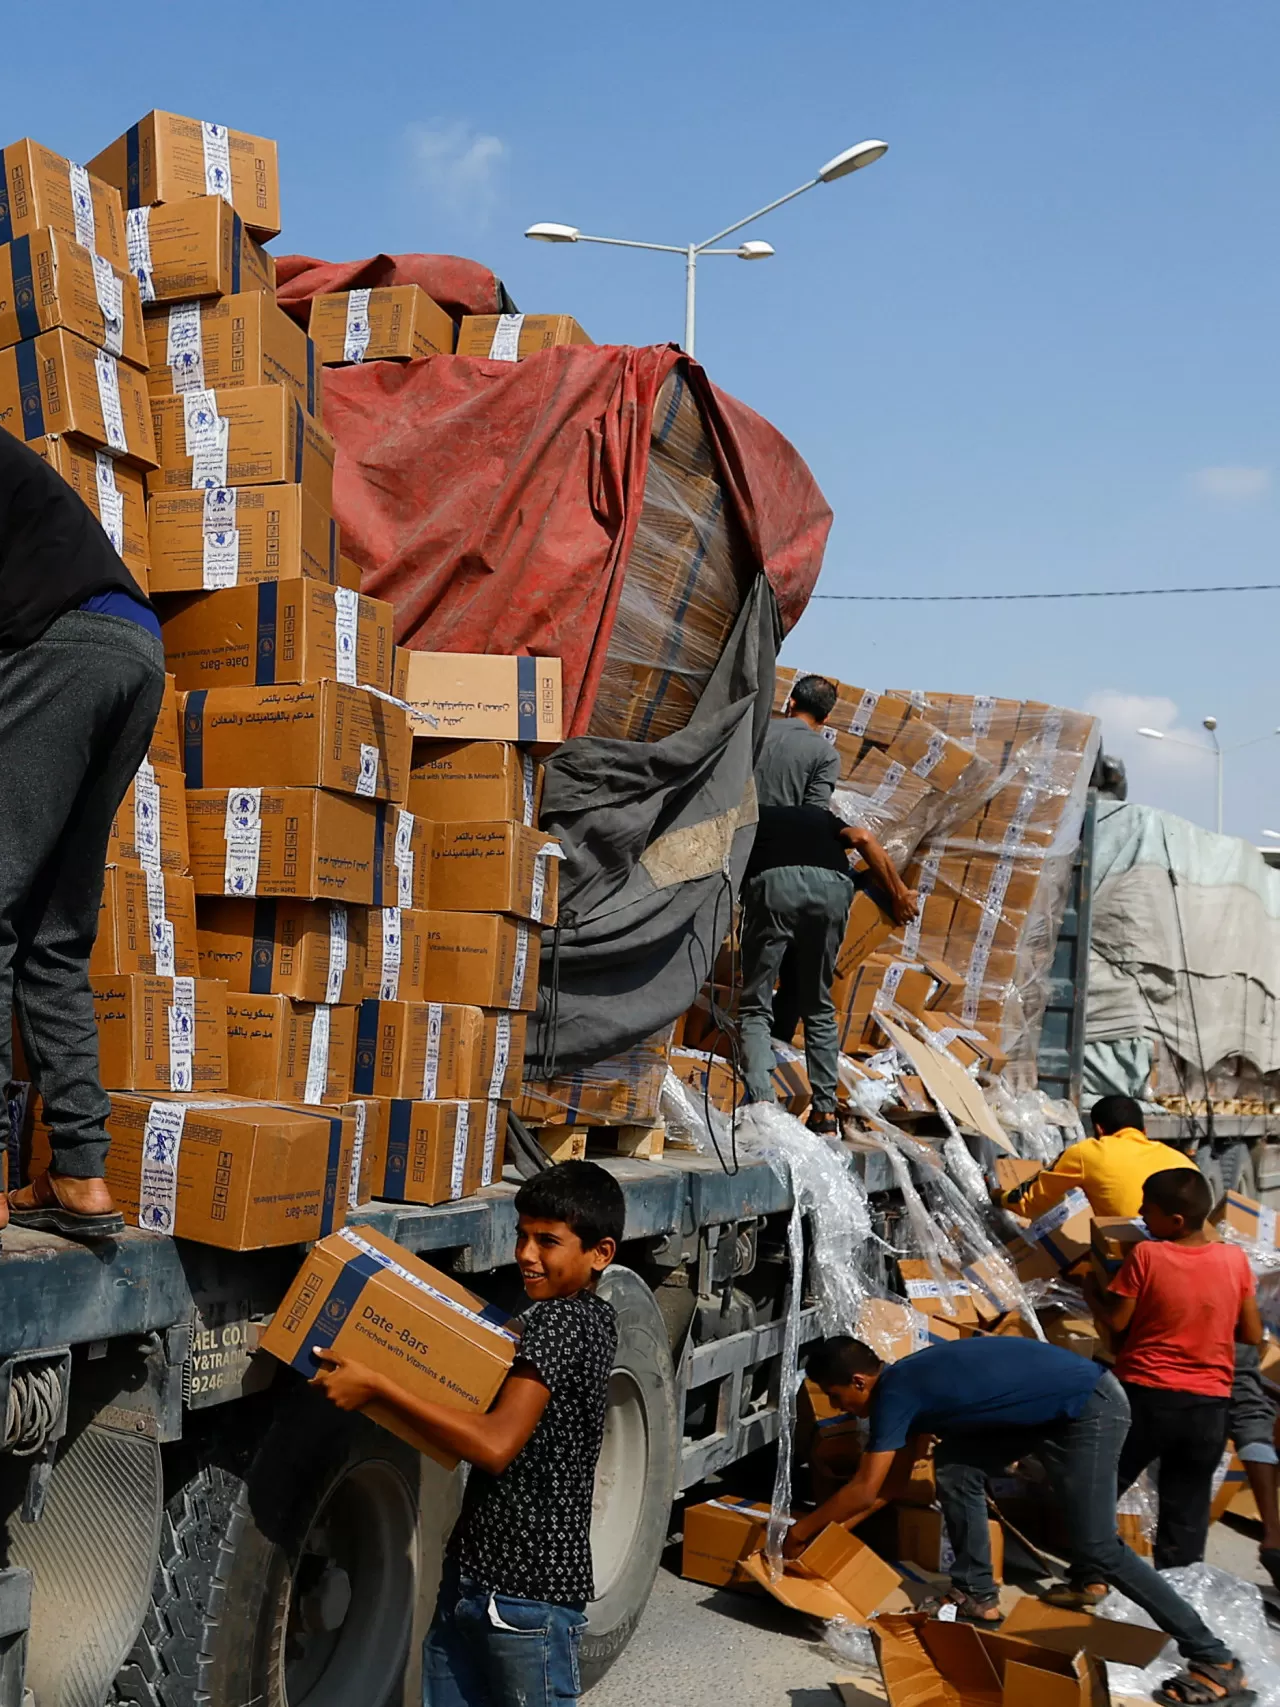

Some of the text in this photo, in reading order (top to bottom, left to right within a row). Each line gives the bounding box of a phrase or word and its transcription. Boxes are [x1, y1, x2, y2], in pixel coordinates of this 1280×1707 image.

[200, 656, 248, 670] Date -Bars
[258, 691, 315, 706] بسكويت بالتمر
[211, 711, 314, 727] مدعم بالفيتامينات والمعادن
[427, 760, 452, 769] -Bars
[454, 832, 505, 843] بسكويت بالتمر
[442, 850, 505, 859] مدعم بالفيتامينات
[104, 1011, 126, 1021] مدعم
[240, 1010, 274, 1021] بسكويت
[362, 1305, 429, 1355] Date -Bars
[355, 1322, 480, 1406] Enriched with Vitamins & Minerals
